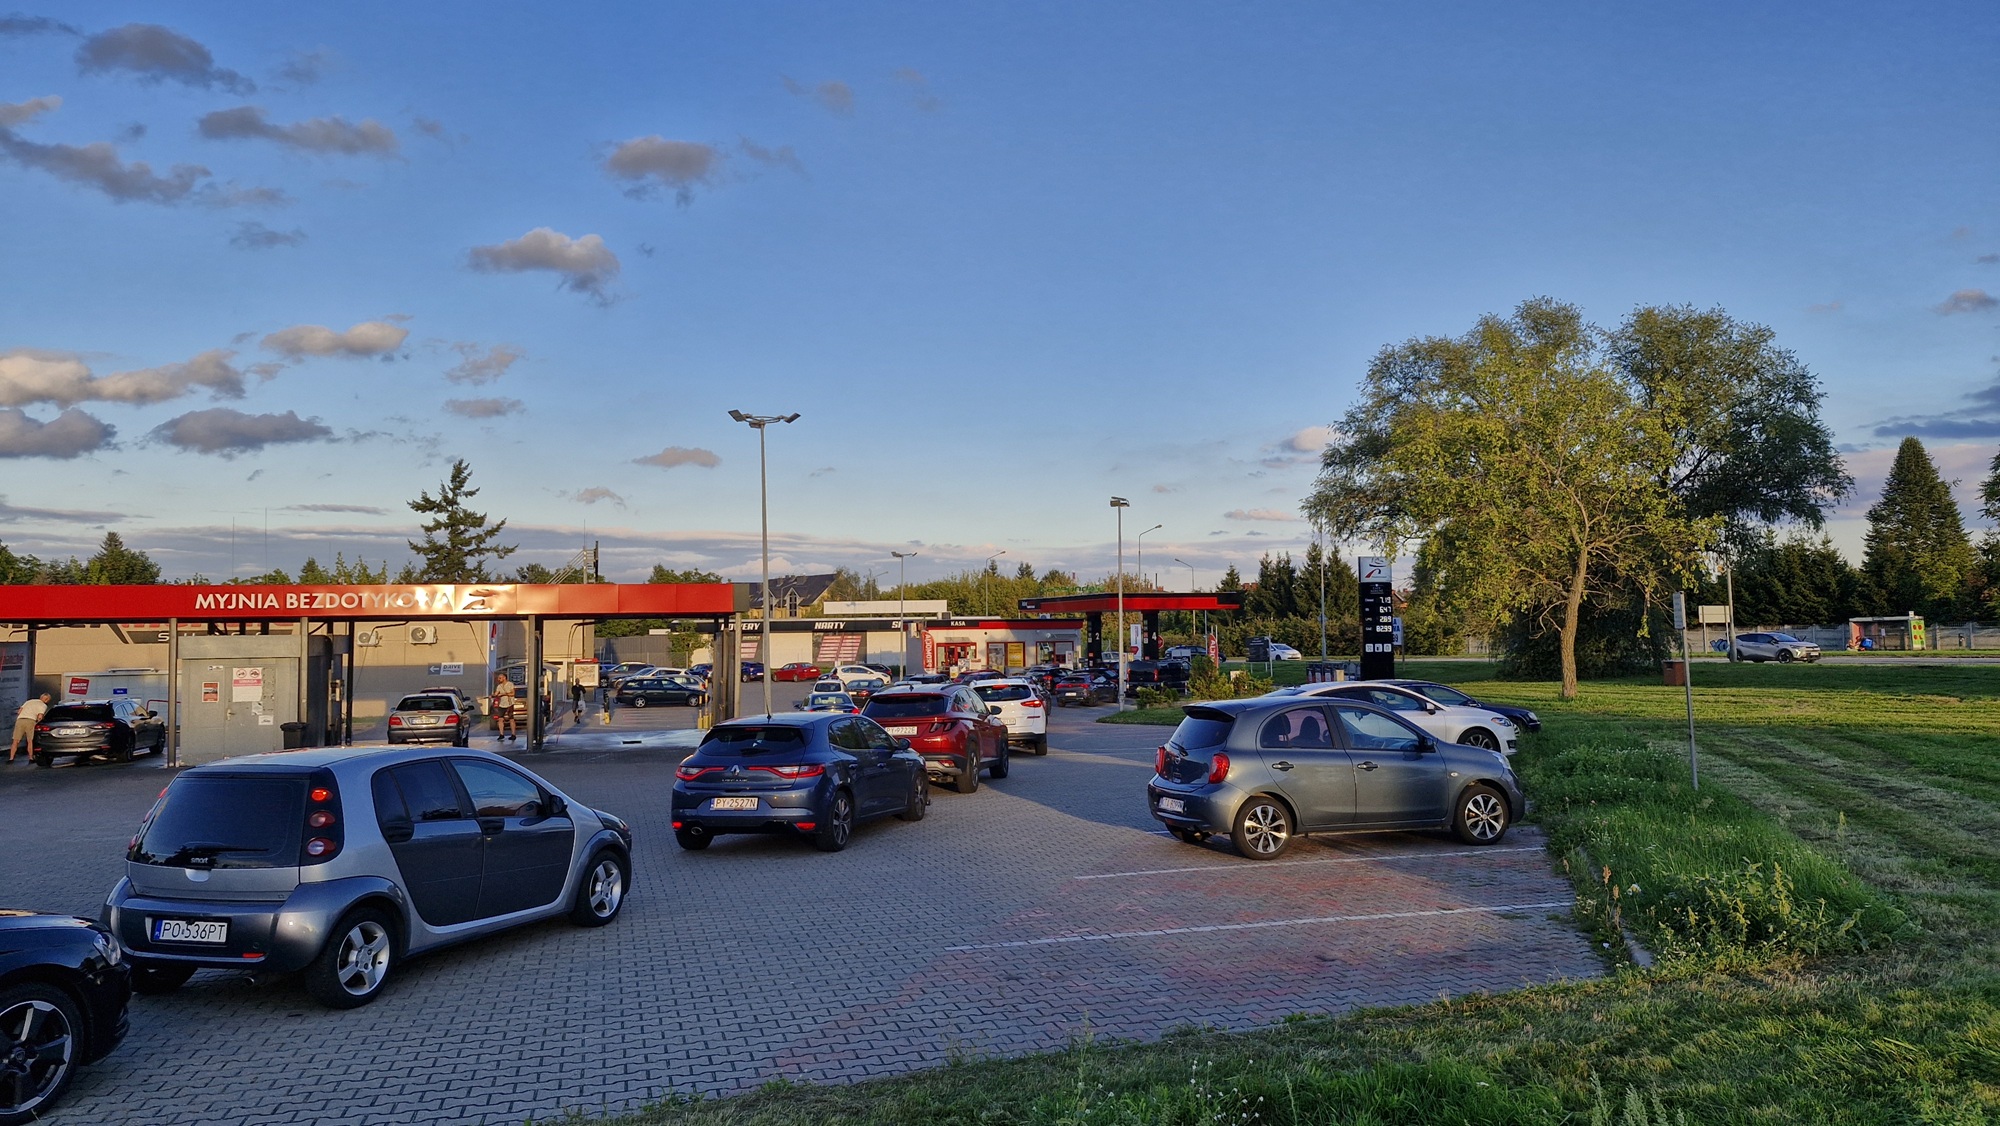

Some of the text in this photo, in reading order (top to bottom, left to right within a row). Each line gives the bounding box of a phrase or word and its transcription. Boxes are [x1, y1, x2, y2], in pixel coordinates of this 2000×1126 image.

[195, 592, 453, 609] MYJNIA BEZDOTYKOWA
[814, 622, 846, 630] NARTY
[1095, 632, 1100, 640] 2
[1151, 632, 1157, 641] 4
[715, 798, 757, 808] PY 2527N
[161, 922, 226, 940] PO 536PT
